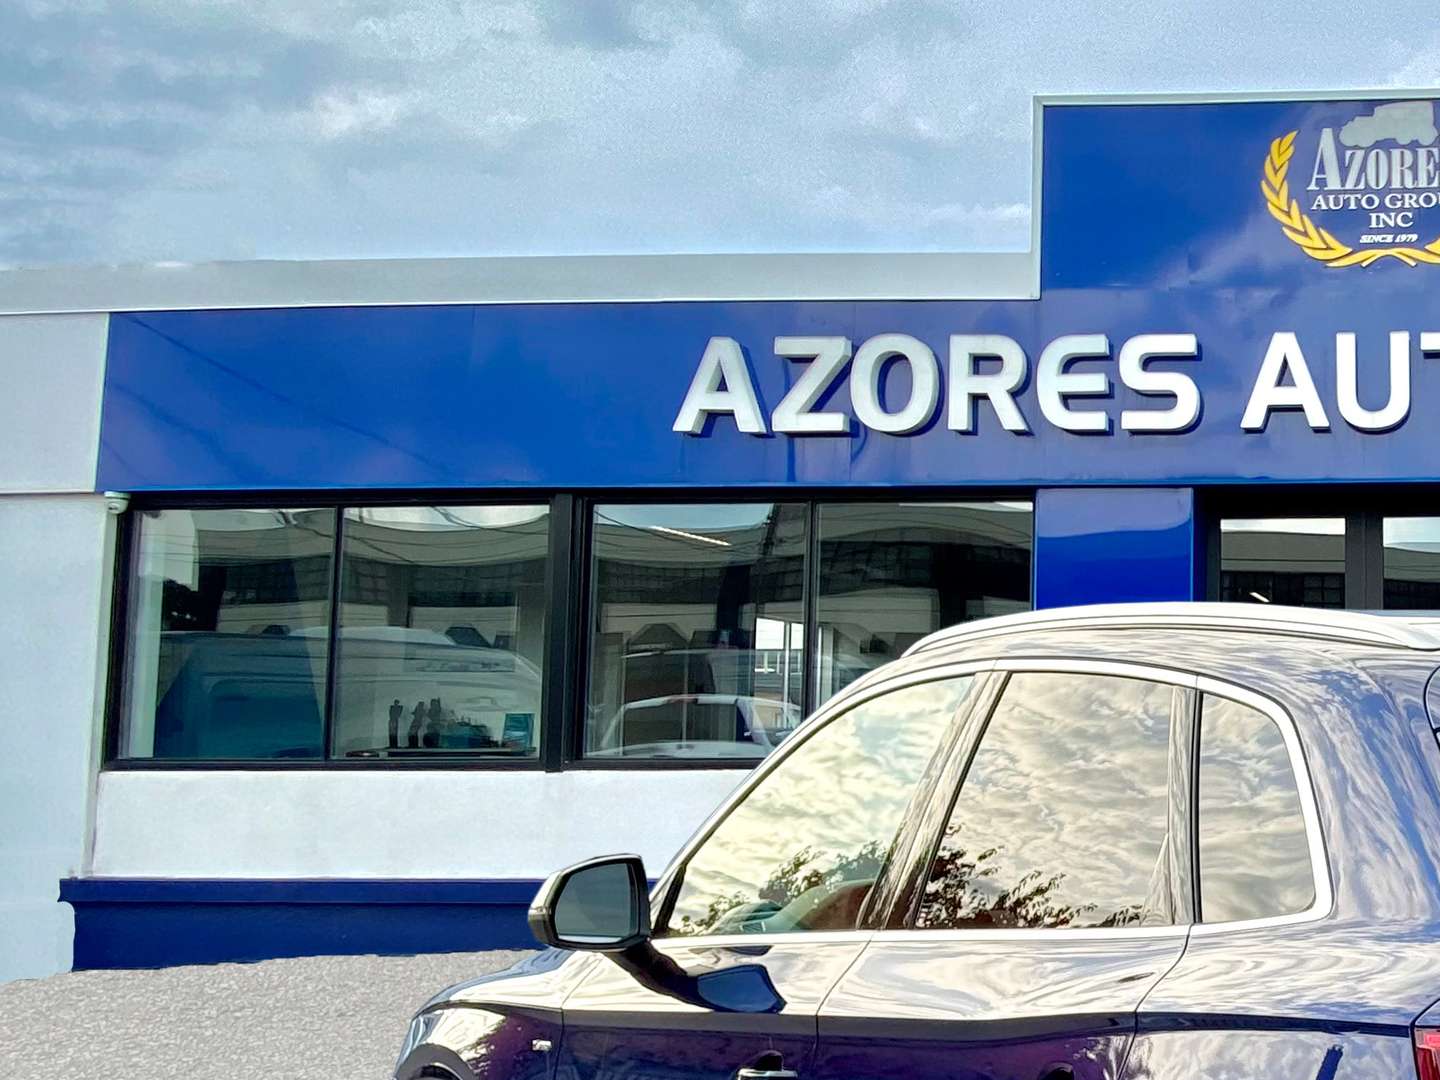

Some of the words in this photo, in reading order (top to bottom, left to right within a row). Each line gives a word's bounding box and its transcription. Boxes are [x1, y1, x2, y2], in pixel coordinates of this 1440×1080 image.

[1311, 194, 1379, 211] AUTO
[1368, 212, 1413, 228] INC
[1360, 234, 1393, 243] SINCE
[1395, 233, 1418, 243] 1979
[672, 333, 1202, 434] AZORES
